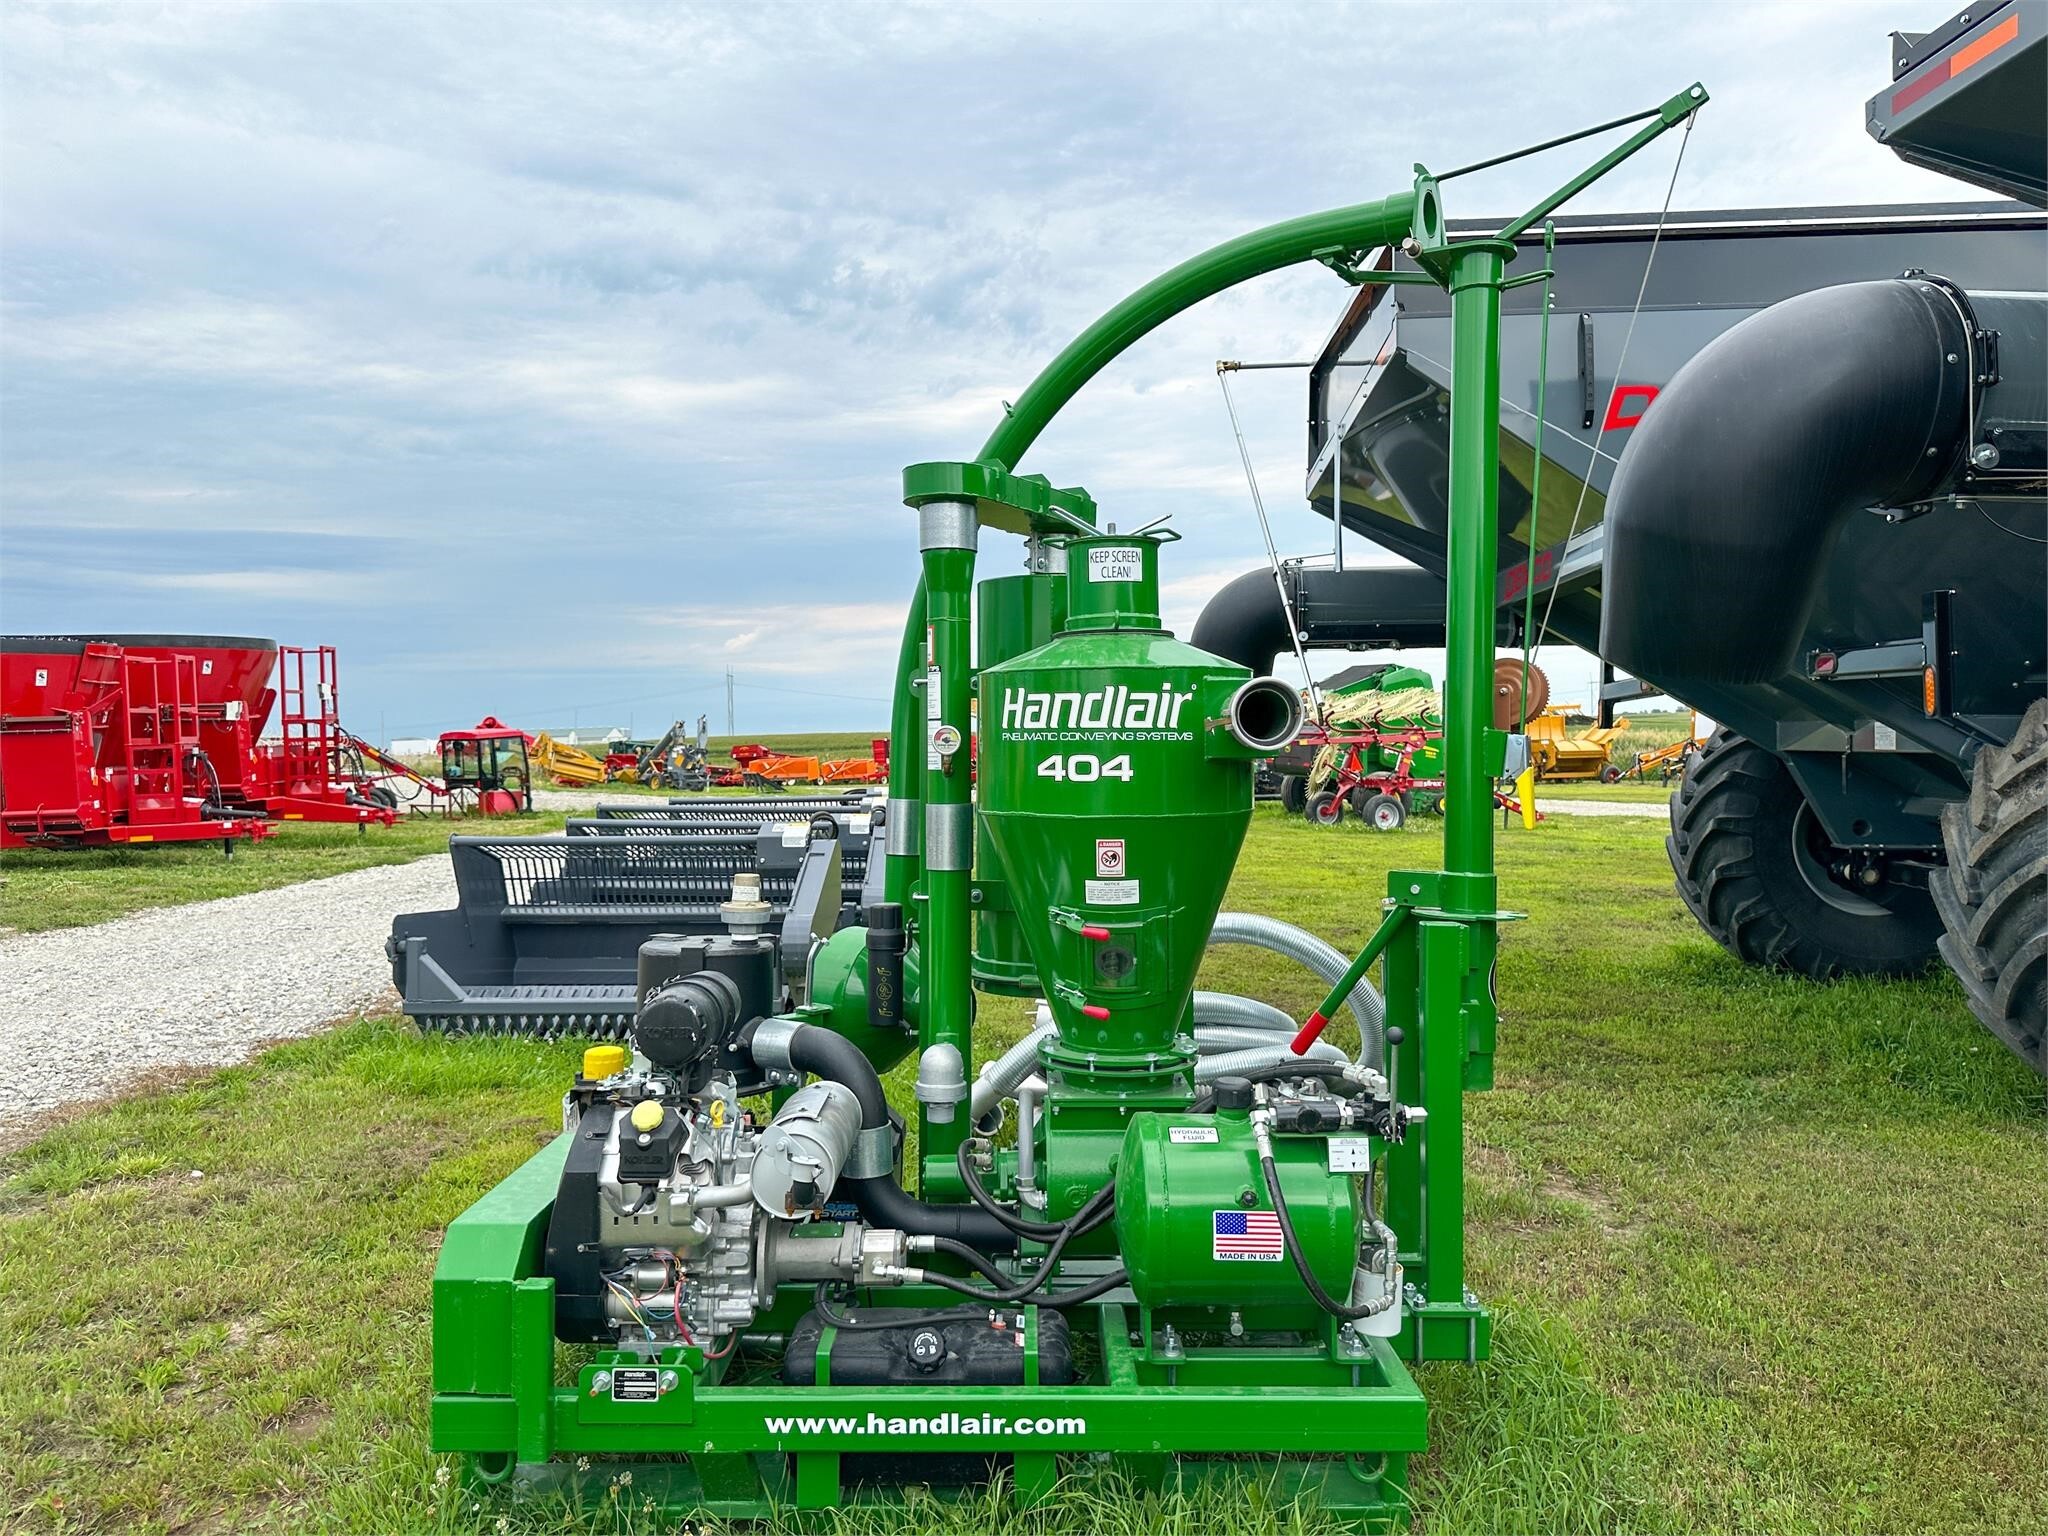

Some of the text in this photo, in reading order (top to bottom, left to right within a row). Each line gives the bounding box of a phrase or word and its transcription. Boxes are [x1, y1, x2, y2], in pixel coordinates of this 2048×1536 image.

[1090, 550, 1141, 563] KEEP SCREEN
[1101, 565, 1132, 579] CLEAN!
[1001, 682, 1193, 729] Handlair
[1002, 732, 1193, 741] PNEUMATIC CONVEYING SYSTEMS
[1037, 754, 1134, 782] 404
[624, 1155, 664, 1165] KOHLER
[1219, 1252, 1245, 1260] MADE
[764, 1412, 1086, 1435] www.handlair.com
